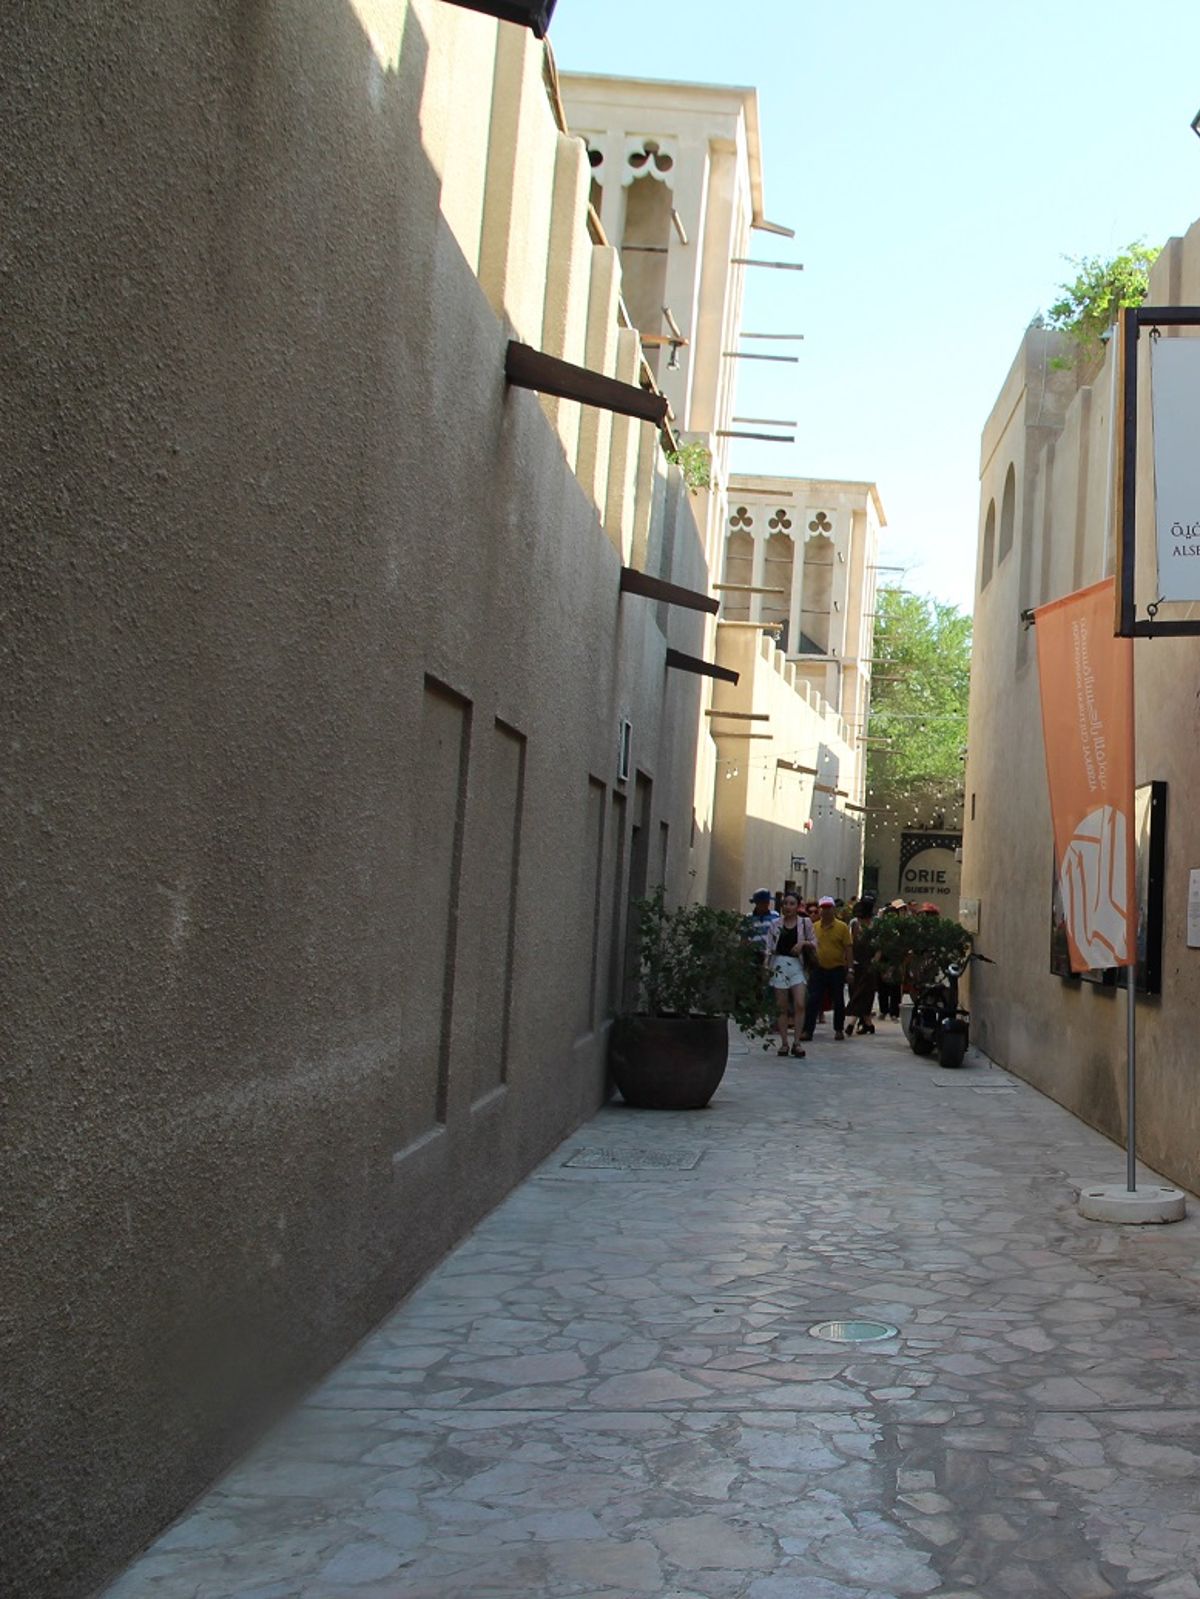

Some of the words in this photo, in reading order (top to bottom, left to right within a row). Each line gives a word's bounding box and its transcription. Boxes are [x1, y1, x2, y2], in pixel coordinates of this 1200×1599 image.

[905, 869, 947, 883] ORIE
[904, 886, 935, 894] GUEST
[937, 887, 951, 895] HO
